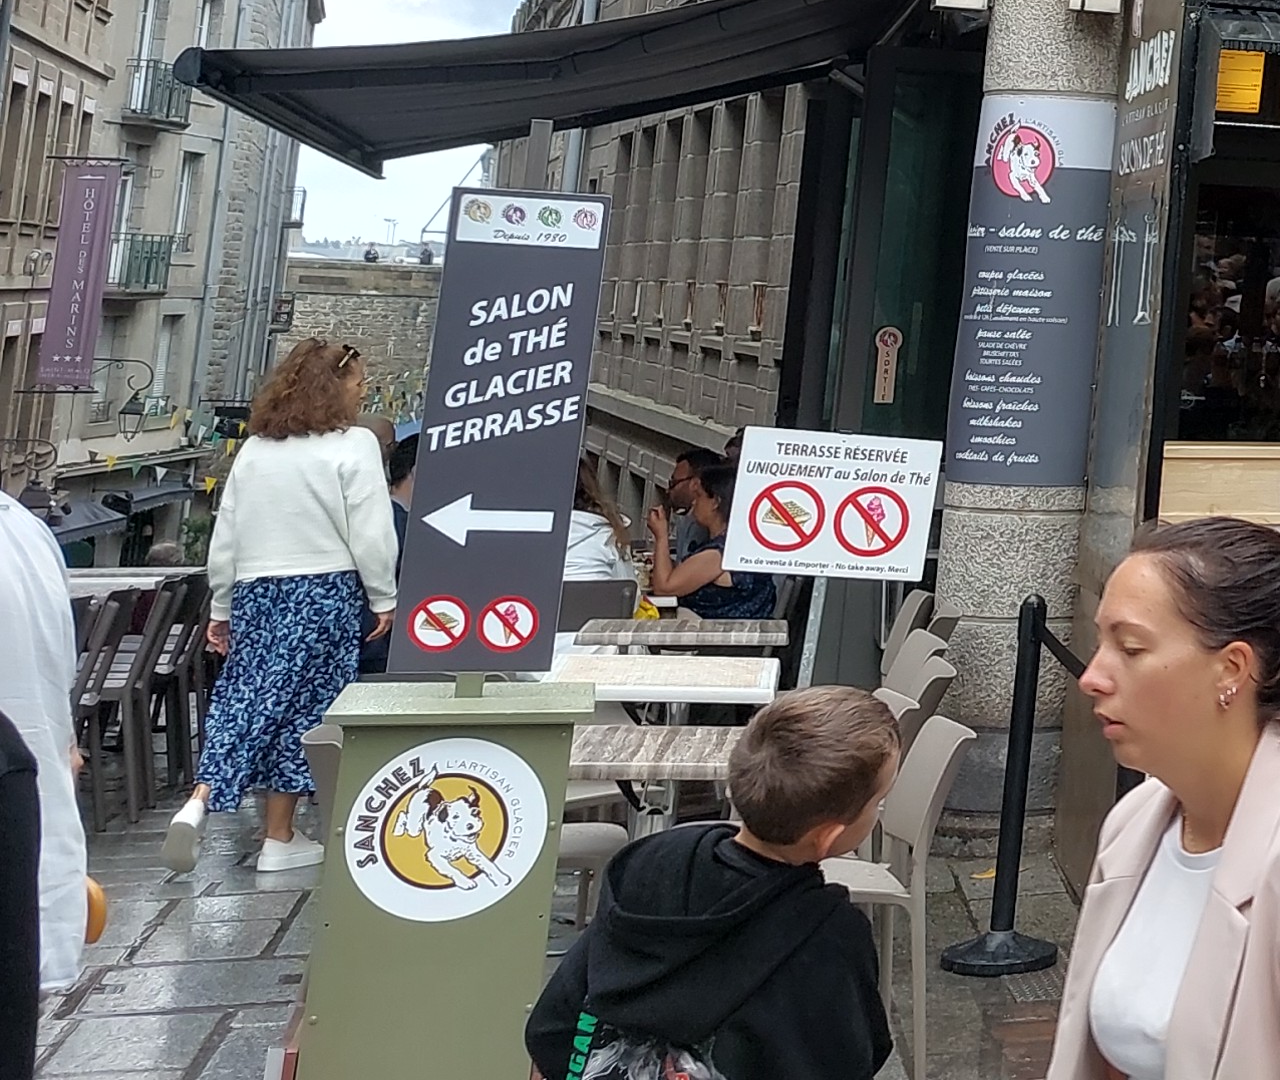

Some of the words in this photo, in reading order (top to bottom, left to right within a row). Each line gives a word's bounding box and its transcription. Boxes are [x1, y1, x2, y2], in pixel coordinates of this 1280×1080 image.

[80, 188, 95, 245] HÔTEL
[493, 230, 530, 242] Depuis
[536, 233, 567, 243] 1980
[998, 223, 1042, 239] salon
[1048, 224, 1071, 239] de
[65, 279, 84, 349] MARINS
[470, 283, 573, 327] SALON
[1012, 288, 1052, 298] maison
[463, 336, 501, 366] de
[508, 317, 569, 357] THÉ
[444, 360, 572, 408] GLACIER
[881, 350, 890, 401] SORTIE
[999, 371, 1043, 384] chaudes
[426, 396, 580, 451] TERRASSE
[746, 461, 833, 479] UNIQUEMENT
[834, 471, 850, 480] au
[853, 469, 887, 483] Salon
[890, 471, 905, 484] de
[909, 472, 931, 486] Thé
[777, 442, 841, 459] TERRASSE
[844, 446, 908, 464] RÉSERVÉE
[992, 451, 1005, 463] de
[1007, 451, 1040, 466] fruits
[740, 557, 752, 565] Pas
[765, 559, 786, 567] vente
[794, 560, 829, 570] Emporter
[847, 563, 864, 571] take
[888, 565, 909, 574] Merci
[354, 757, 425, 868] SANCHEZ
[446, 759, 513, 794] L'ARTISAN
[505, 798, 523, 859] GLACIER
